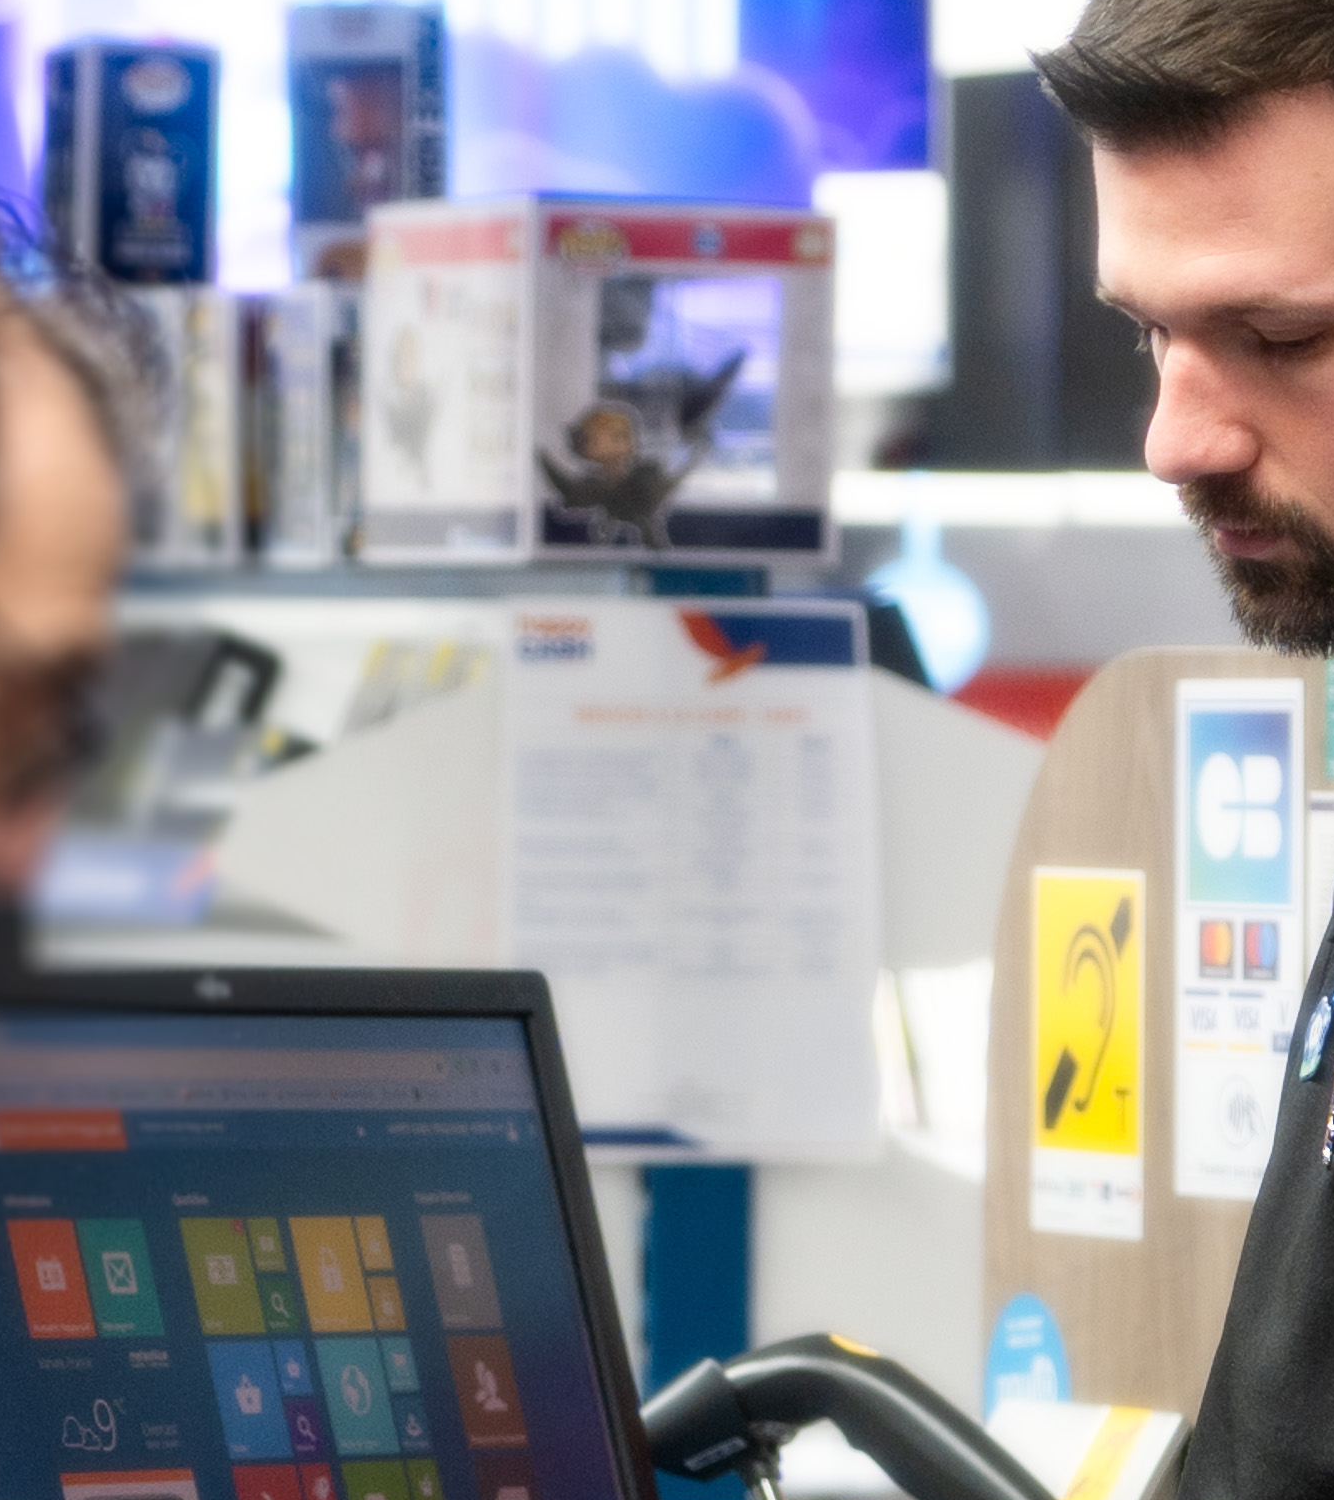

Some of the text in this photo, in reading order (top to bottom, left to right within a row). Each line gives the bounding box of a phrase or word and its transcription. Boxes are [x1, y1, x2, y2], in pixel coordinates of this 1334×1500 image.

[1196, 752, 1283, 860] CB
[1190, 1006, 1219, 1031] VISA
[1234, 1006, 1262, 1031] VISA
